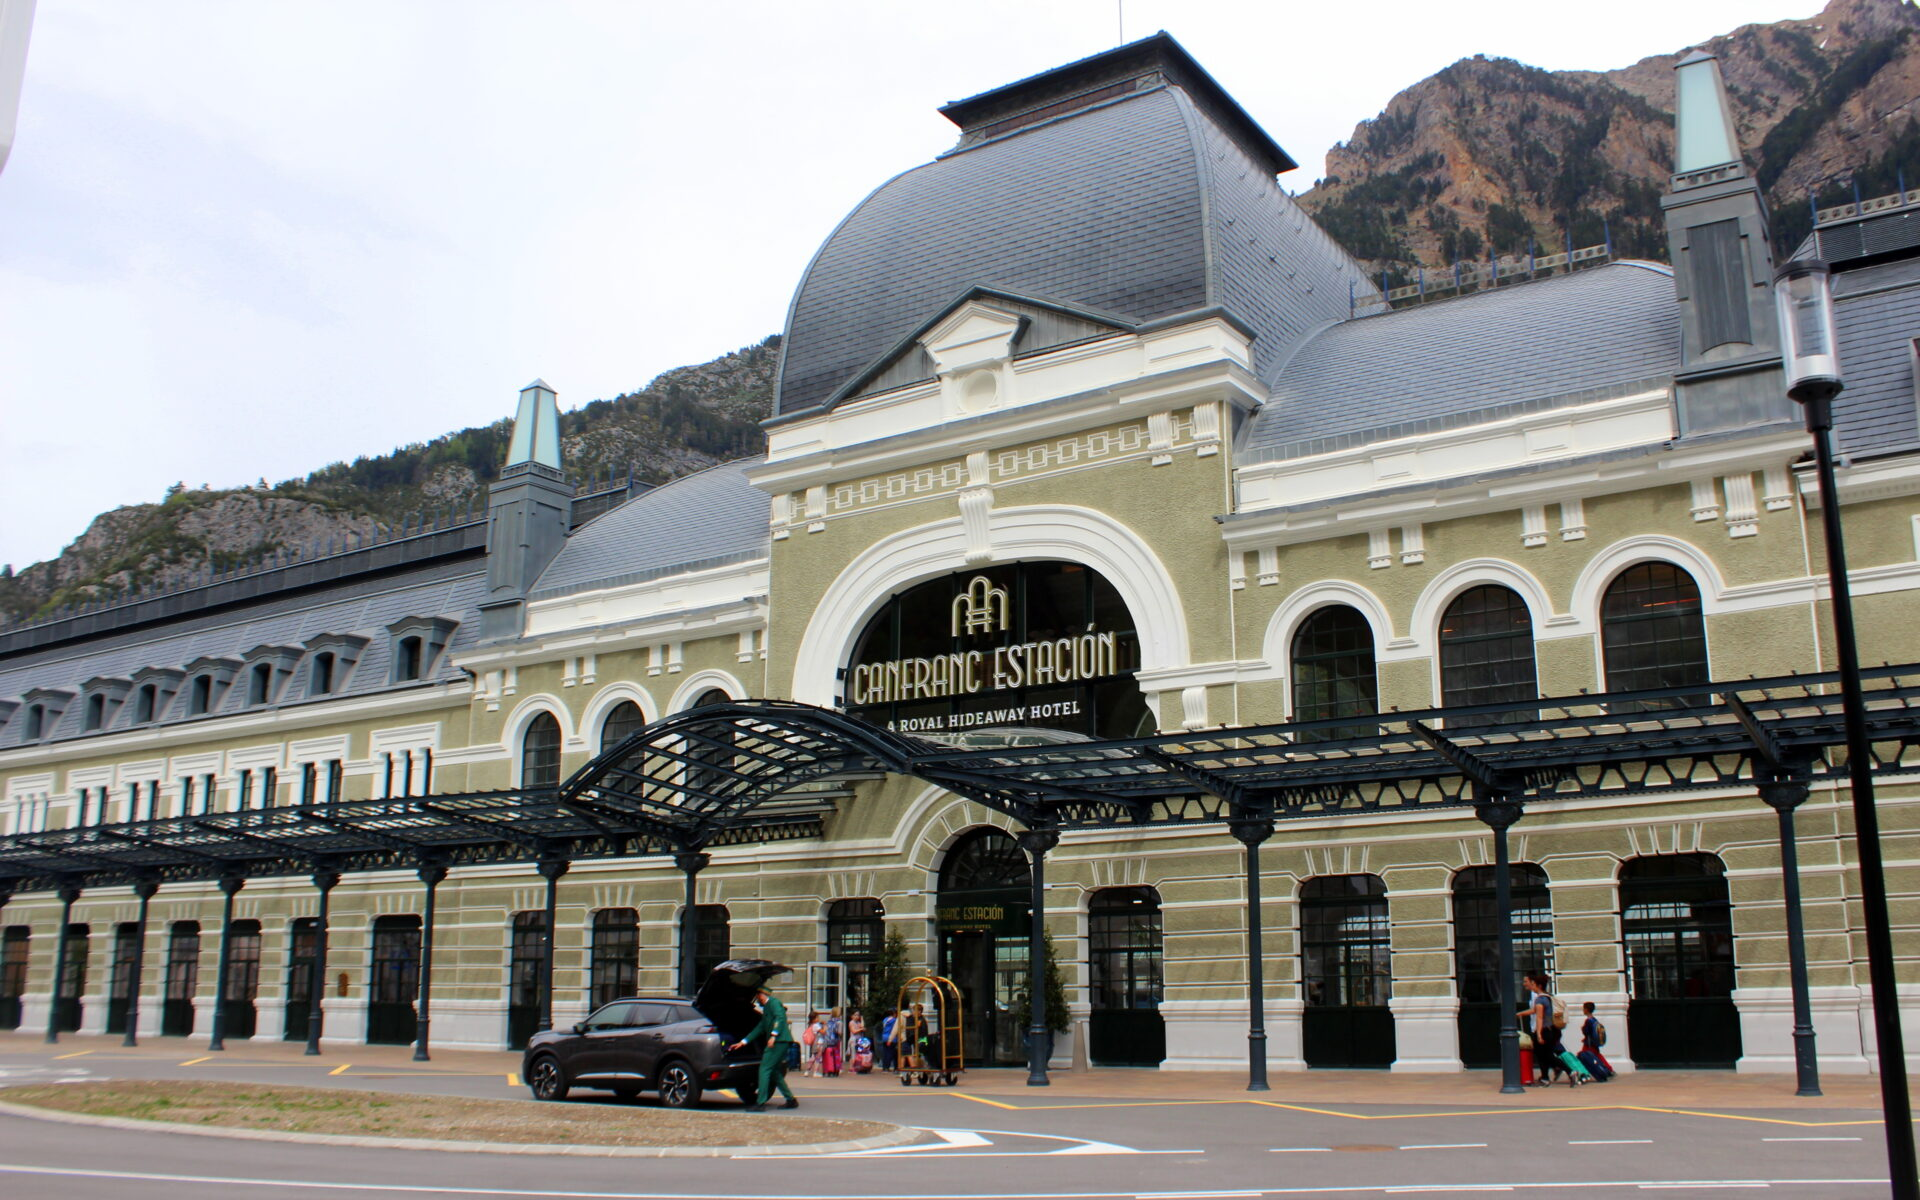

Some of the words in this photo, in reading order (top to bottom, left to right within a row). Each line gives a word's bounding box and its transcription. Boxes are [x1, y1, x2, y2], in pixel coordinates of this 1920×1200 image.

[853, 650, 984, 705] CANFRANC
[993, 622, 1118, 690] ESTACIÓN
[887, 720, 897, 733] A
[900, 715, 944, 732] ROYAL
[948, 707, 1026, 728] HIDEAWAY
[1030, 701, 1080, 719] HOTEL
[963, 903, 1004, 920] ESTACIÓN
